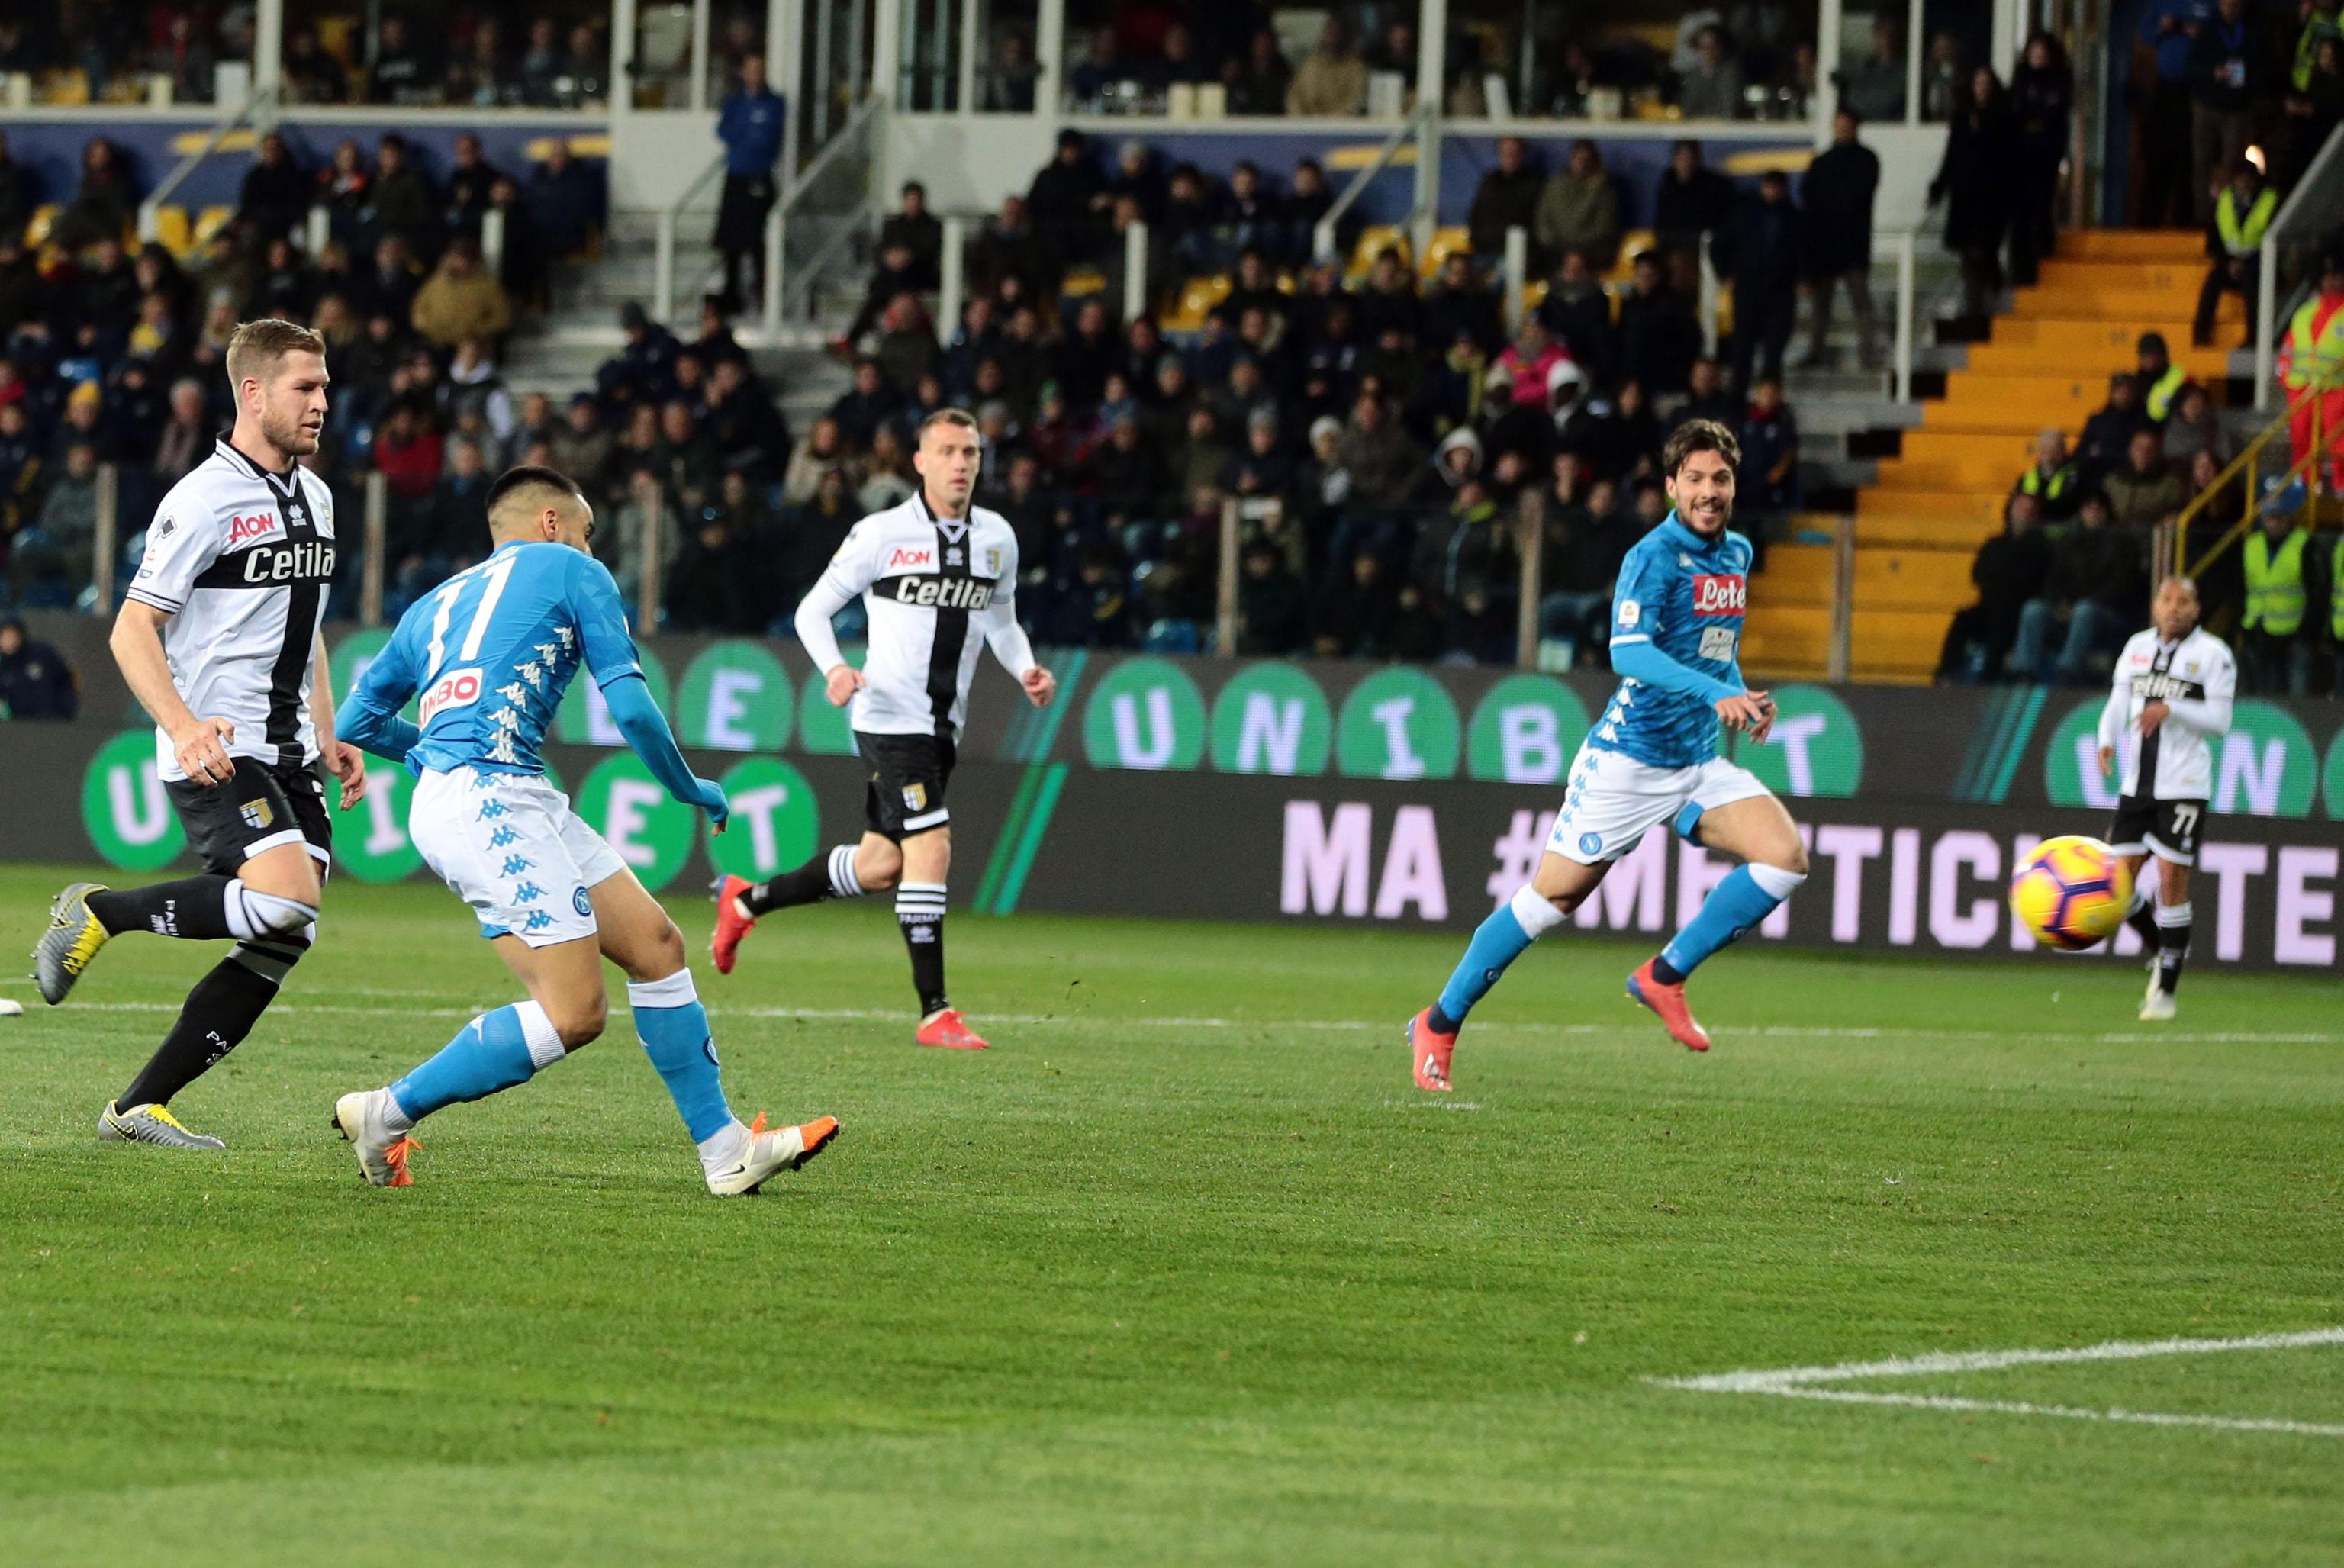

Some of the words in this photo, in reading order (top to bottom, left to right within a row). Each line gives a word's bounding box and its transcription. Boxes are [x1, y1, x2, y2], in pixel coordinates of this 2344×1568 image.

[1693, 578, 1746, 612] Lete
[1111, 688, 1827, 797] UNIBT
[2171, 803, 2199, 837] 77
[1280, 800, 1449, 921] MA
